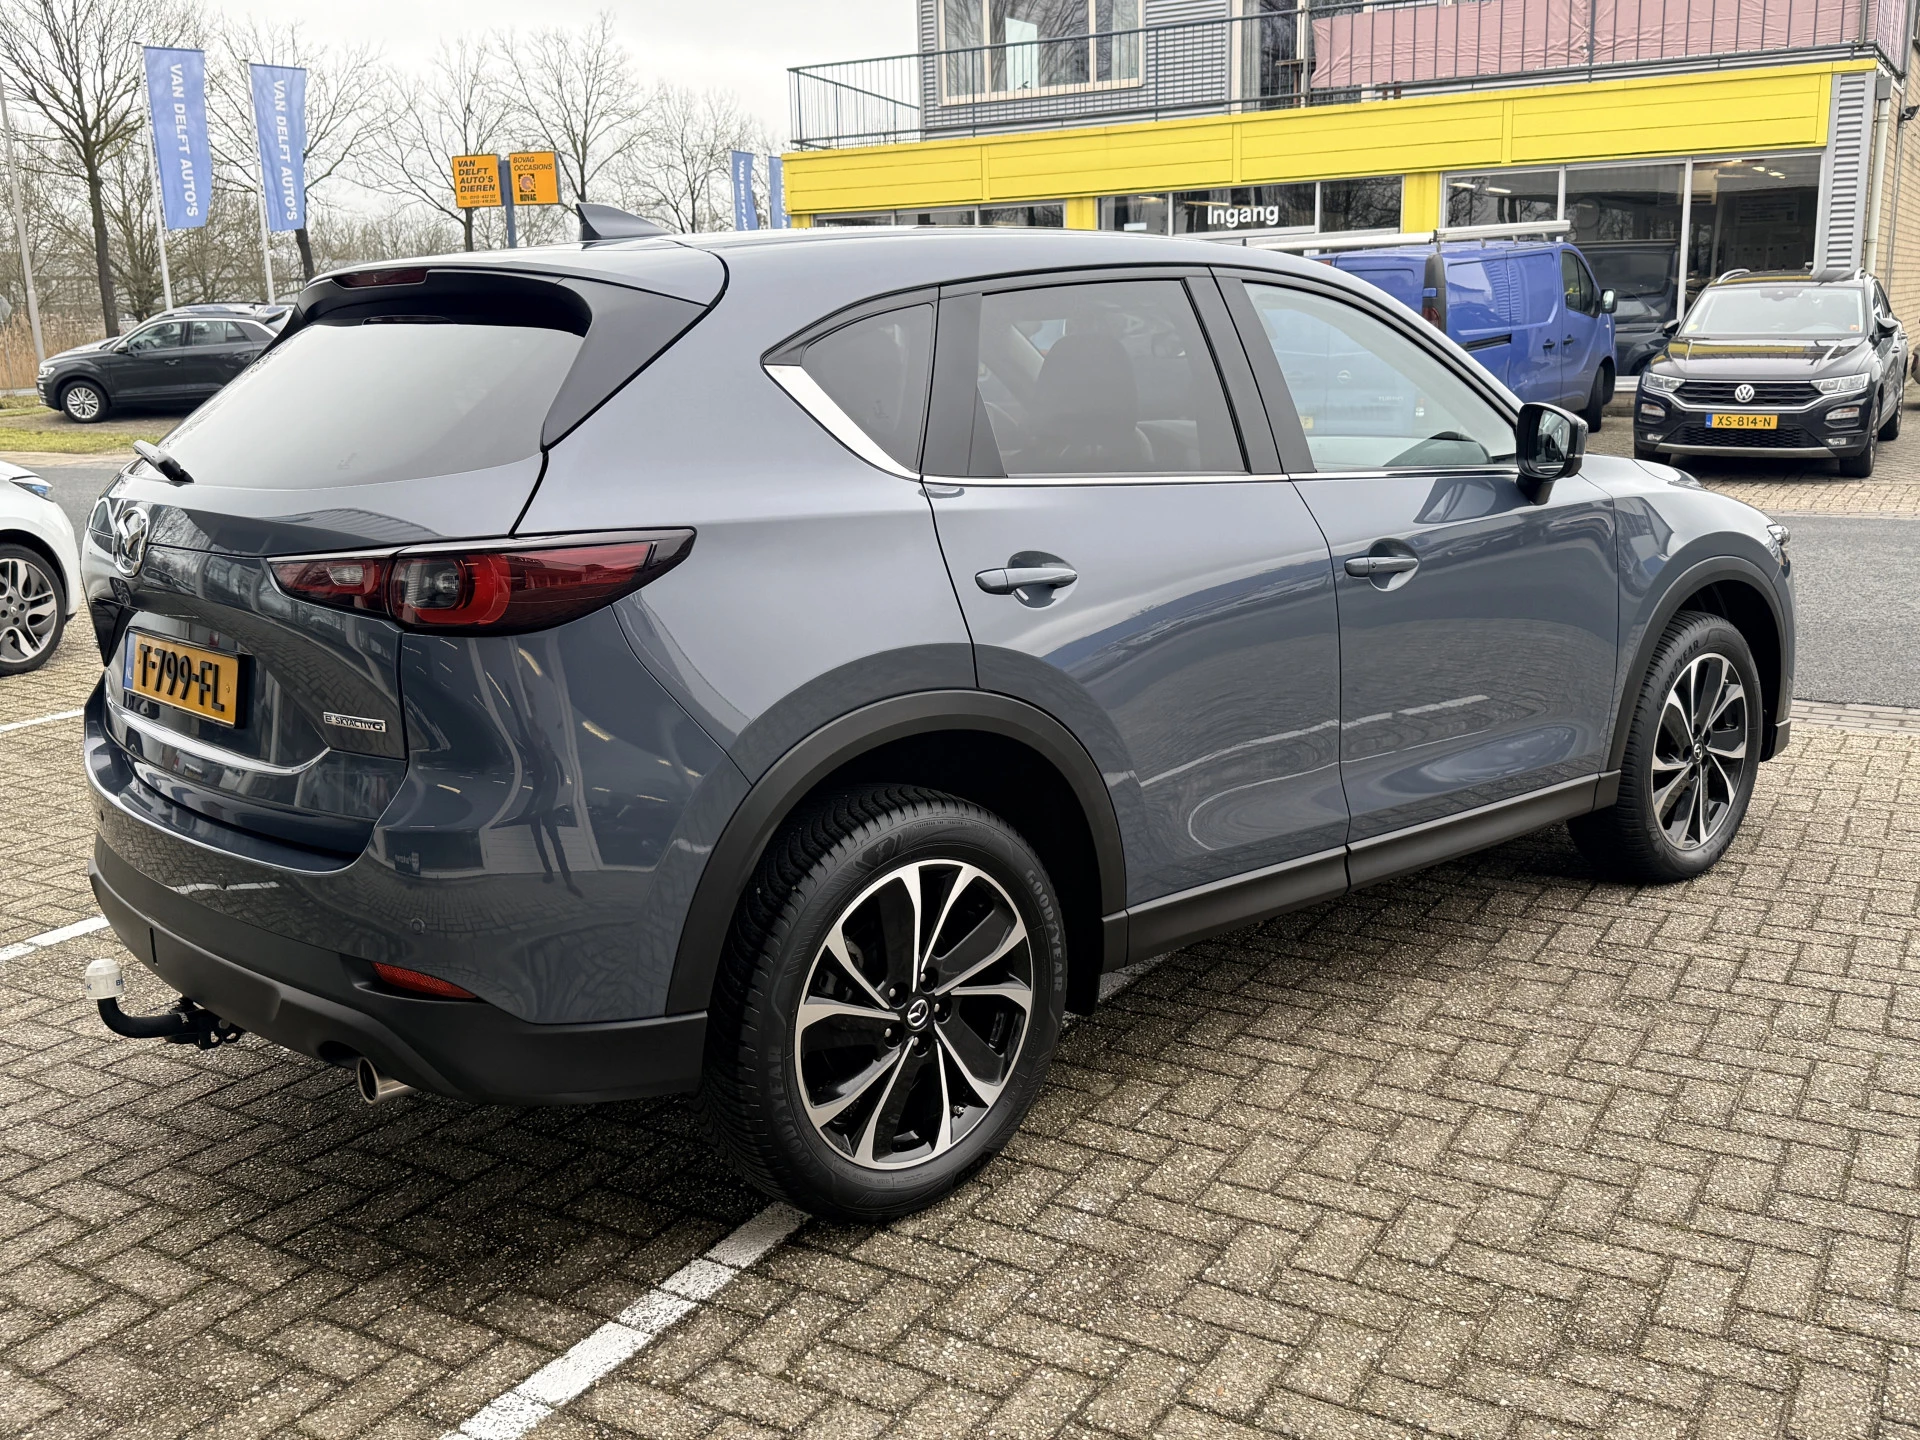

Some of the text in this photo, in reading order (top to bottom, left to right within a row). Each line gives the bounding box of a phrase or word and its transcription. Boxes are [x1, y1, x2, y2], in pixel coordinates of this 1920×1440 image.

[170, 63, 199, 217] VAN DELFT AUTO'S
[274, 79, 298, 221] VAN DELFT AUTO'S
[460, 176, 493, 184] AUTO'S
[460, 184, 496, 193] DIEREN
[1207, 205, 1279, 228] Ingang
[1717, 416, 1772, 427] XS-814-N
[139, 643, 225, 712] T-799-FL
[1656, 639, 1699, 712] GOODYEAR
[1025, 869, 1064, 992] GOODYEAR
